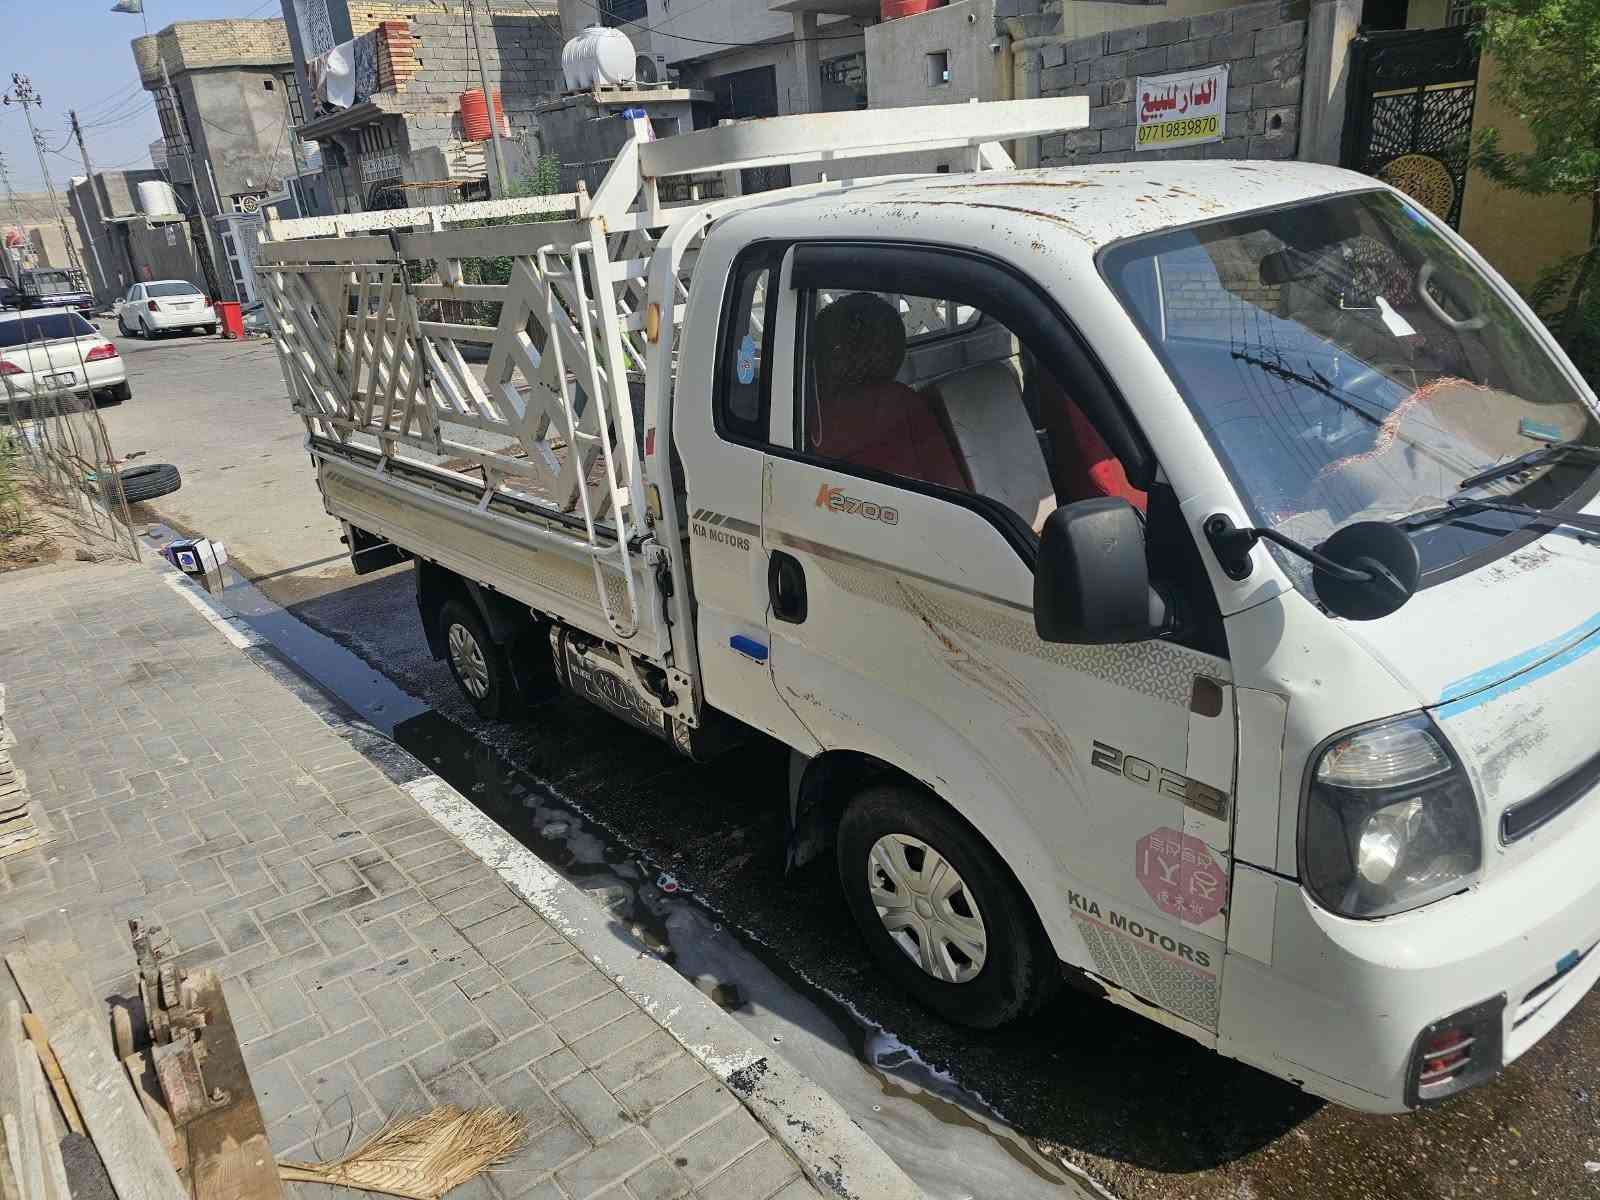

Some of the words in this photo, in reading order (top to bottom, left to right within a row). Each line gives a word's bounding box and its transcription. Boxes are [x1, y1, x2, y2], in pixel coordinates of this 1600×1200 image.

[1141, 83, 1177, 122] للبيع
[1178, 76, 1218, 113] الدار
[1138, 117, 1217, 141] 07719839870
[816, 483, 899, 525] K2700
[692, 523, 708, 538] KIA
[709, 530, 750, 552] MOTORS
[1067, 889, 1102, 918] KIA
[1109, 910, 1211, 967] MOTORS
